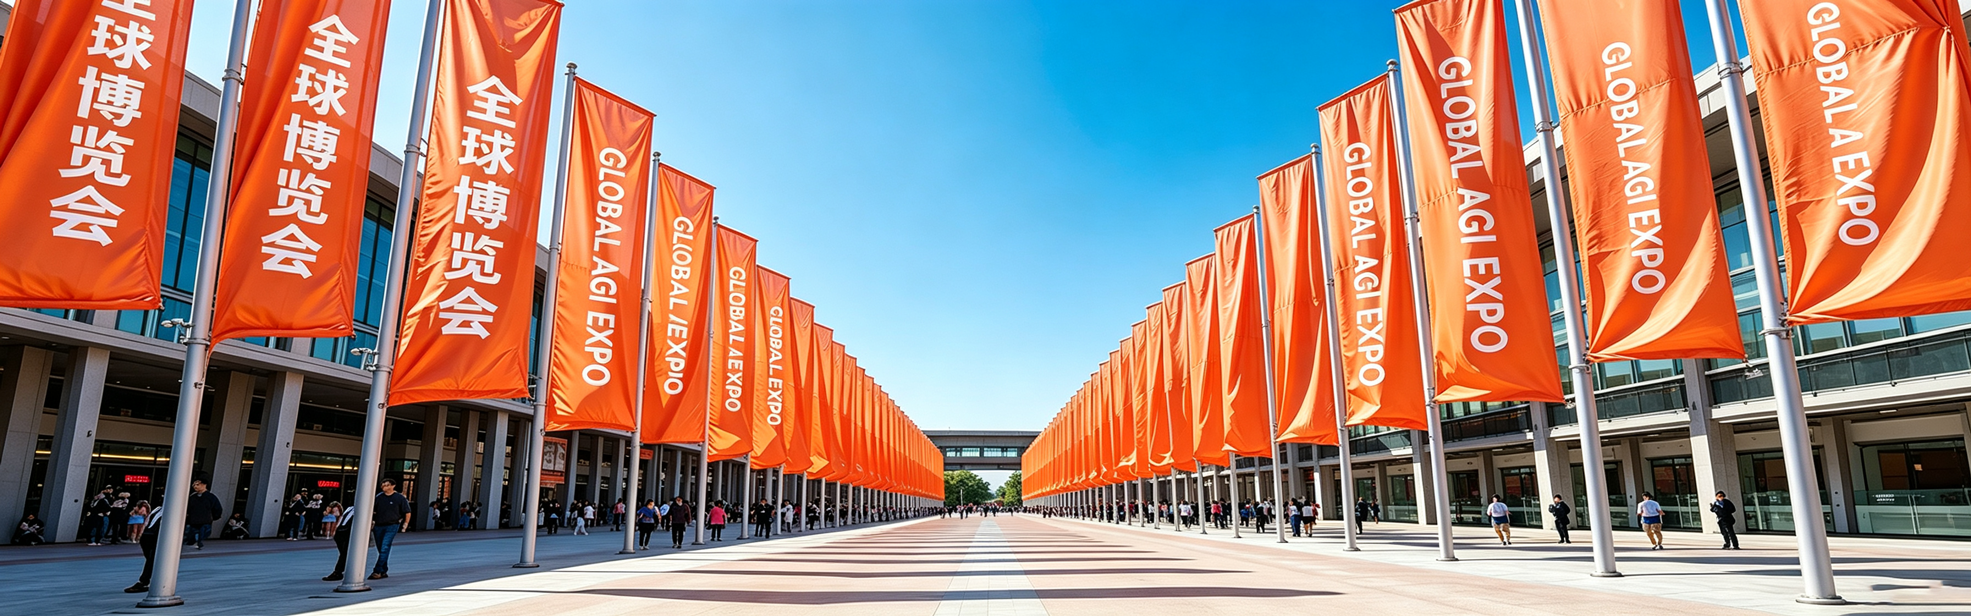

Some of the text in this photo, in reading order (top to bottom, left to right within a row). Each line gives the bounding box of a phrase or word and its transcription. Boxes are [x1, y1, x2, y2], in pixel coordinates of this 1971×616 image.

[261, 14, 360, 279] 全球博览会
[438, 75, 523, 340] 全球博览会
[1438, 55, 1509, 353] GLOBAL AGI EXPO
[1601, 41, 1667, 294] GLOBAL AGI EXPO
[1806, 1, 1859, 124] GLOBAL
[1833, 150, 1881, 246] EXPO
[581, 147, 627, 387] GLOBAL AGI EXPO
[728, 266, 746, 345] GLOBAL
[766, 305, 784, 426] GLOBAL EXPO
[1343, 142, 1386, 387] GLOBAL AGI EXPO
